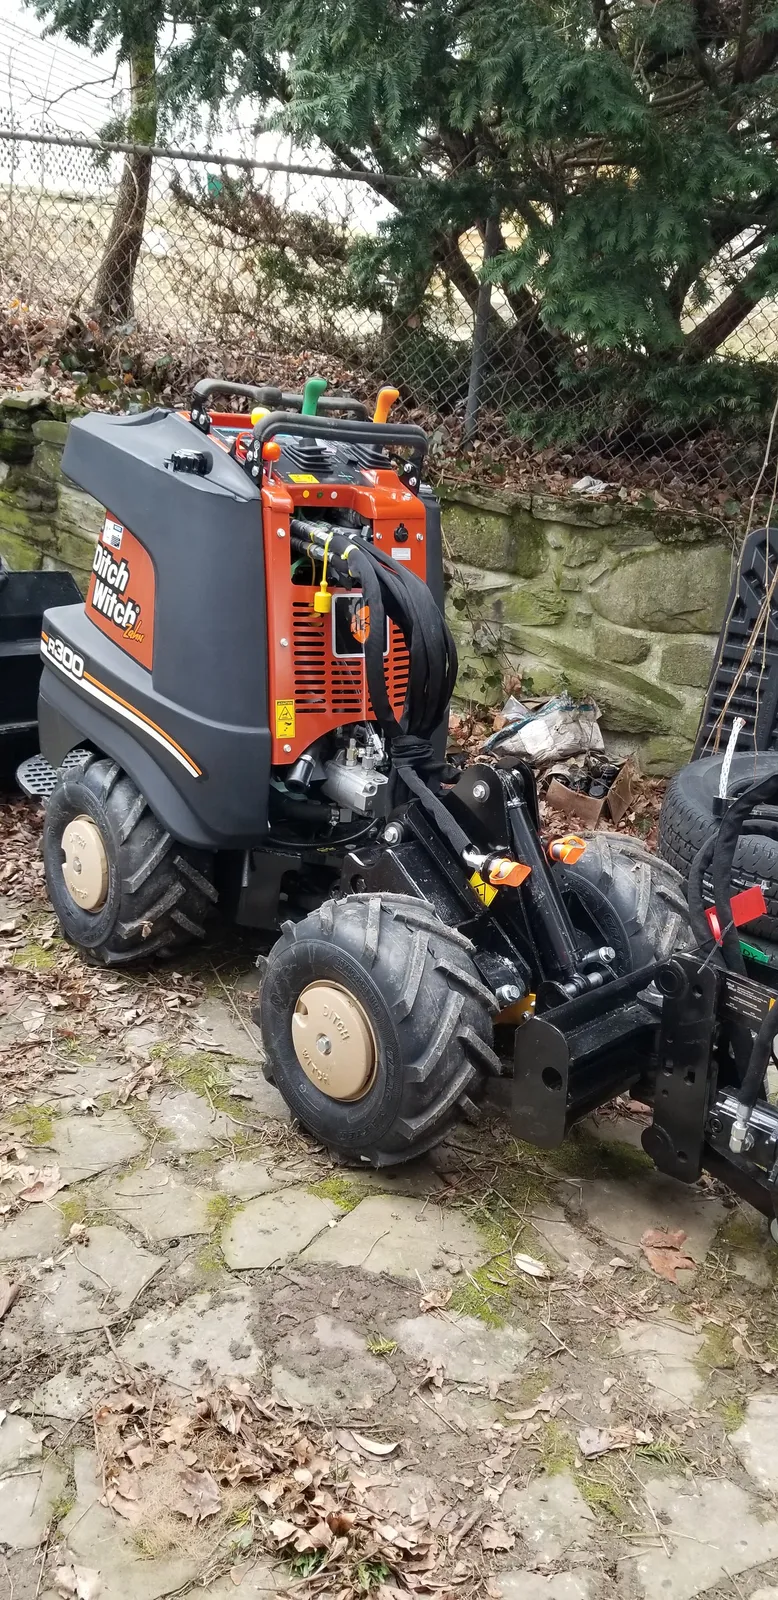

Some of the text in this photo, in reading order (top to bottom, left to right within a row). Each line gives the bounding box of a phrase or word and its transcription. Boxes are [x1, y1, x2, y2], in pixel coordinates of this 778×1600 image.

[92, 543, 129, 592] Ditch
[47, 637, 84, 678] R300
[322, 1003, 351, 1041] DITCH
